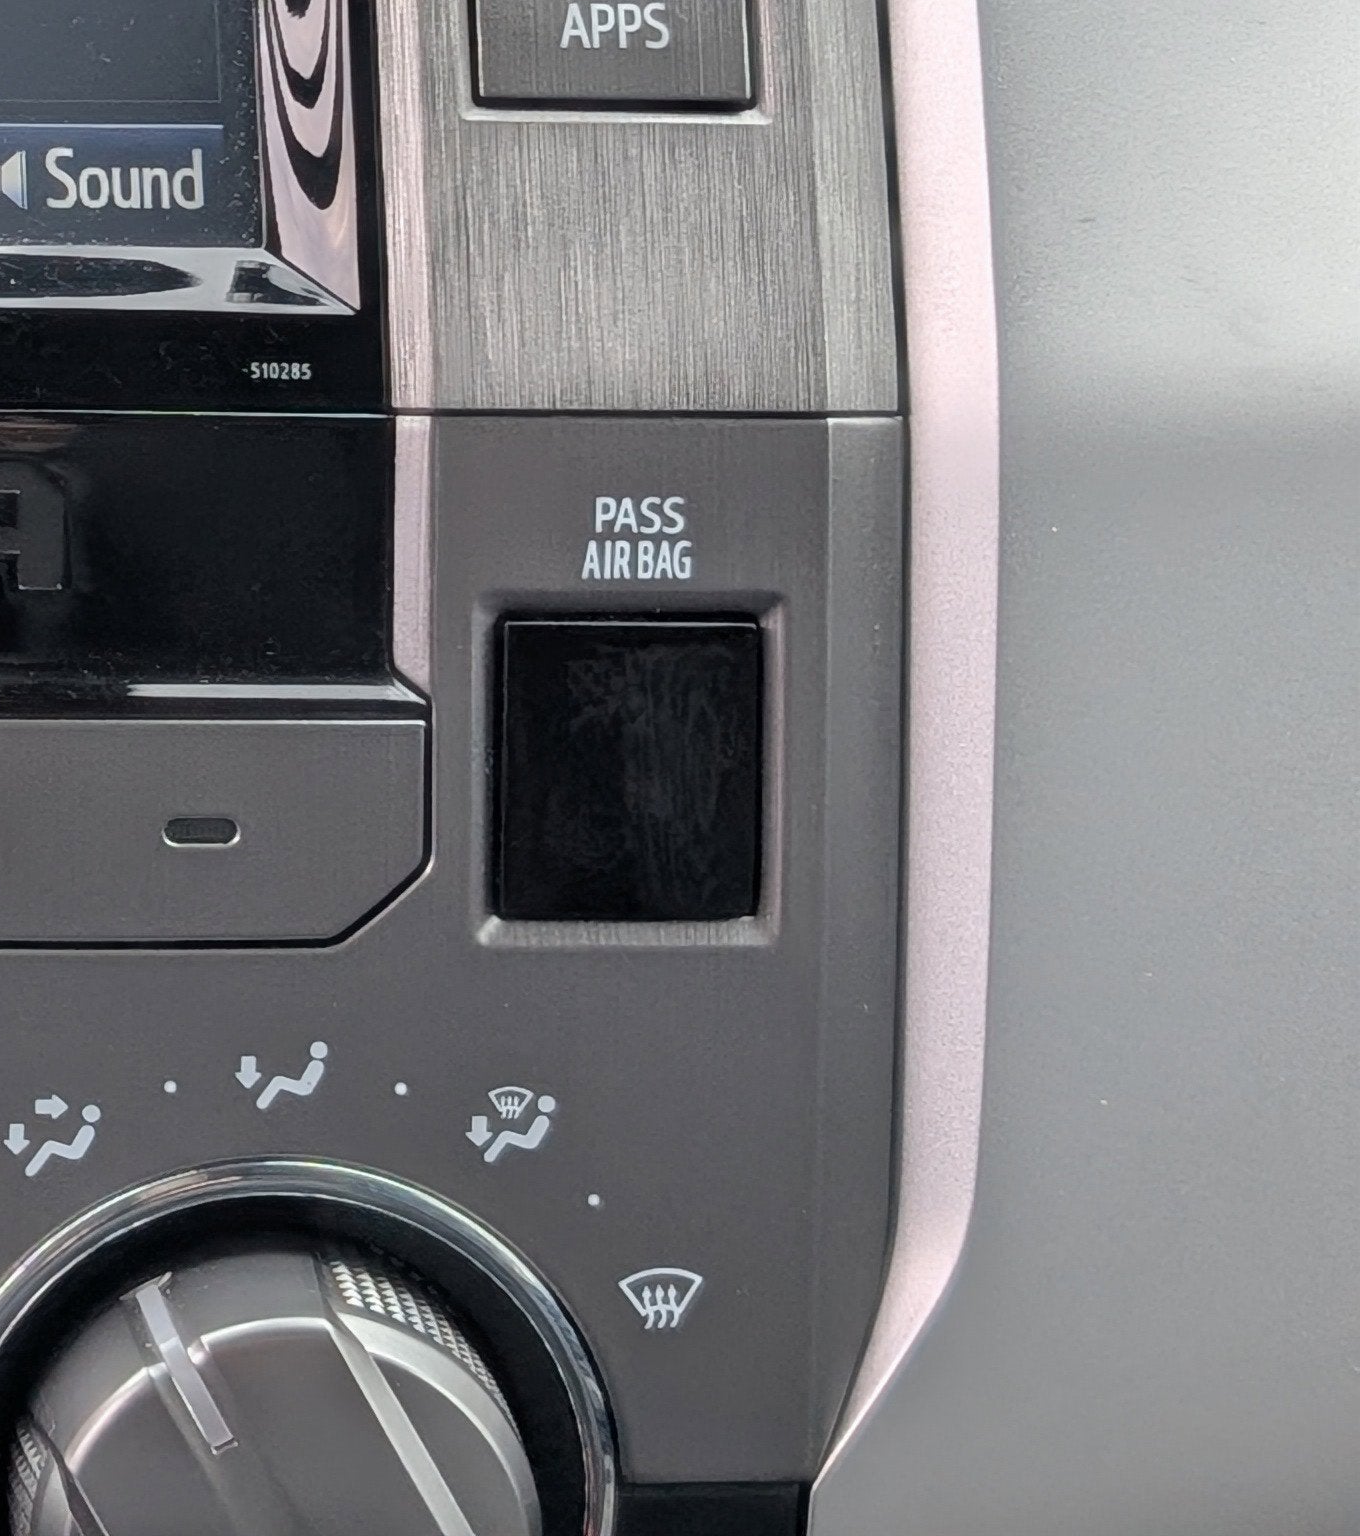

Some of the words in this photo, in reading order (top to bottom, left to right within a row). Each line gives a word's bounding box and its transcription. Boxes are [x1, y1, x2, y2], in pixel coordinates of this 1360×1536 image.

[560, 3, 670, 49] APPS
[45, 147, 206, 211] Sound
[594, 496, 686, 535] PASS
